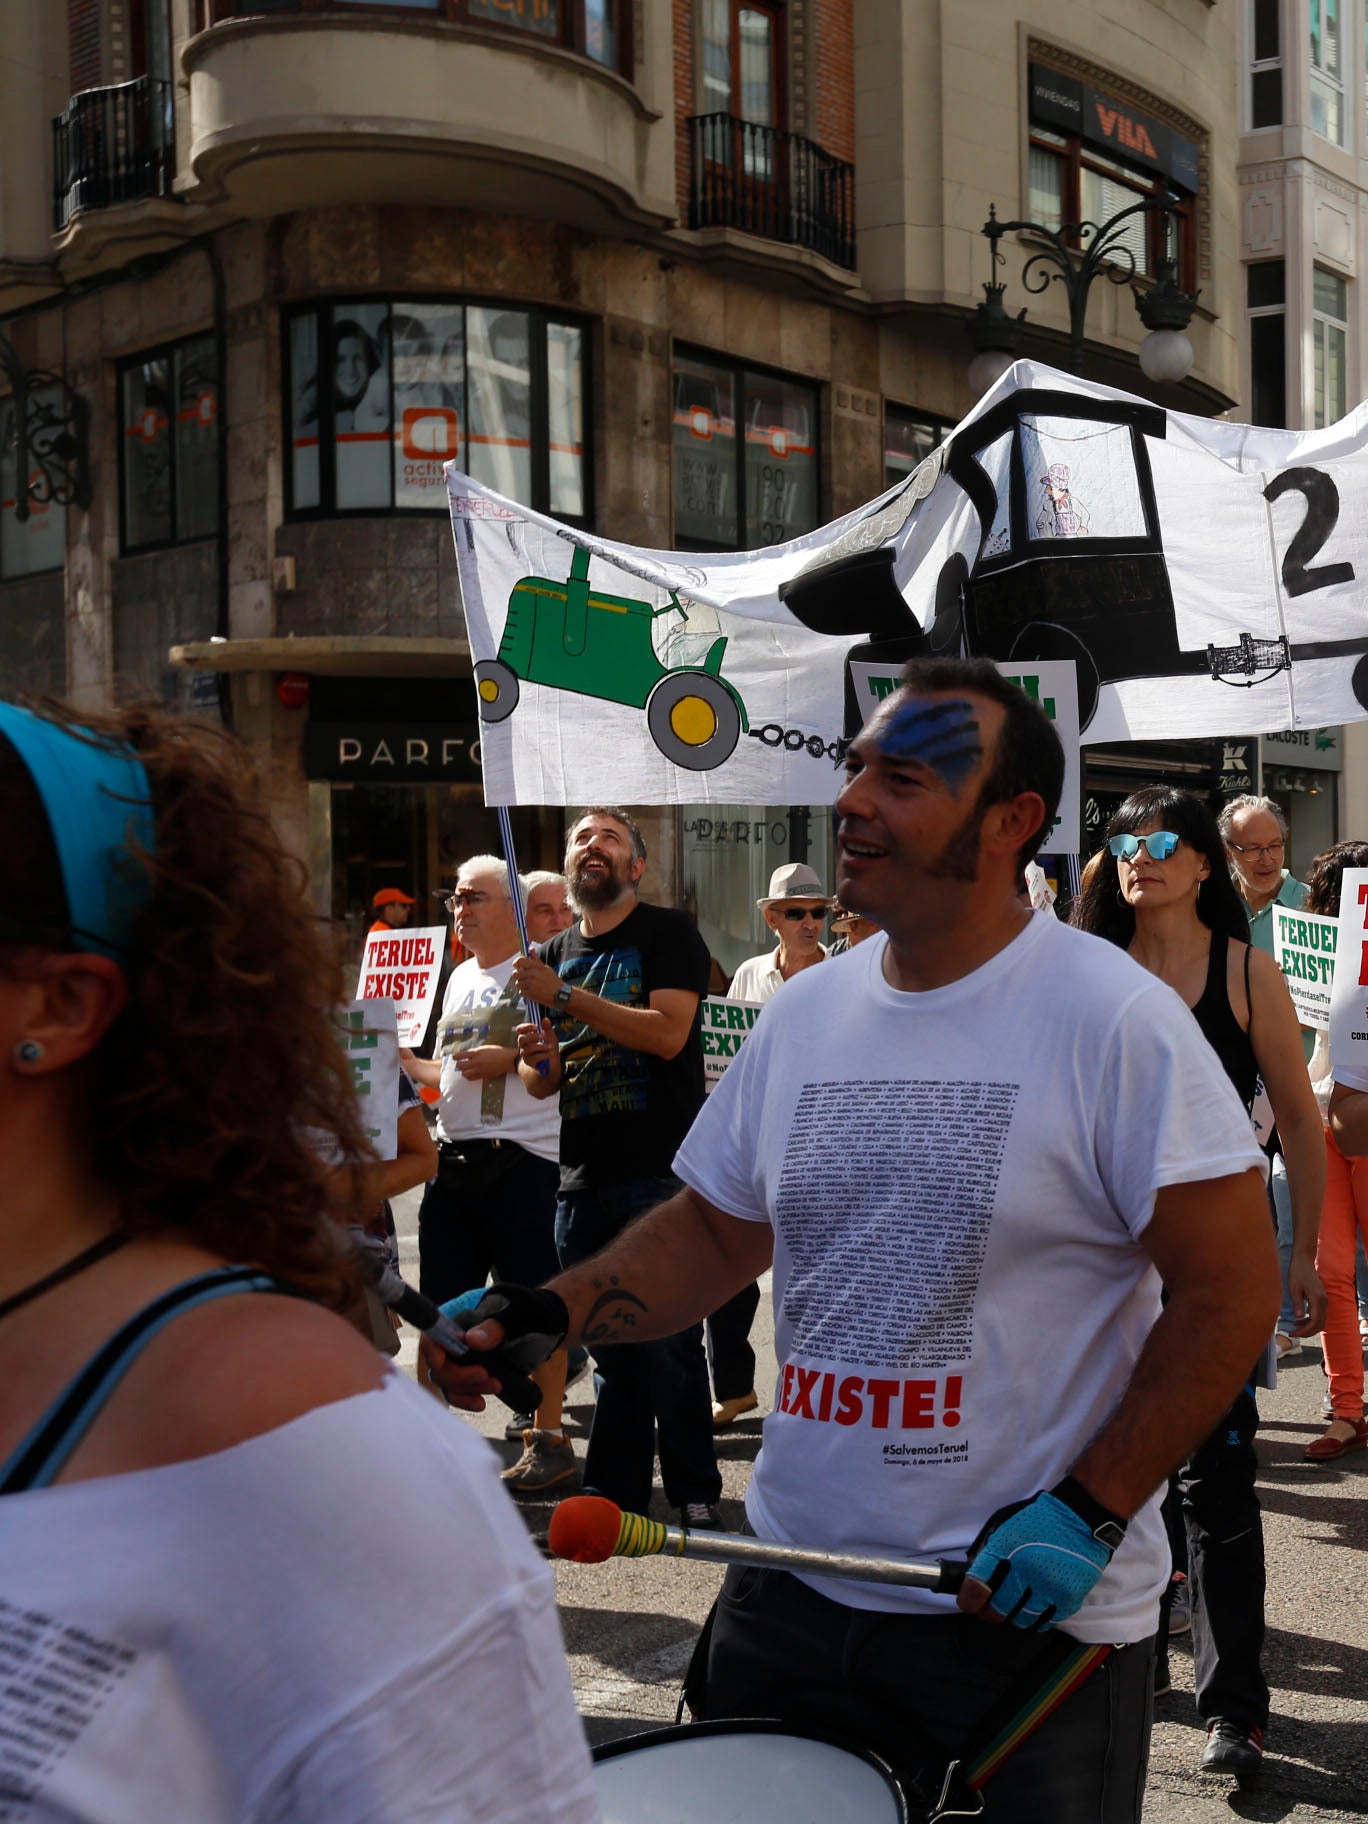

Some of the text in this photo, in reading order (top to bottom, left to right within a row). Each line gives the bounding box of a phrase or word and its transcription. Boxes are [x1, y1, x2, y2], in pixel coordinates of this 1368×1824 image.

[367, 937, 435, 968] TERUEL
[363, 971, 430, 1000] EXISTE
[777, 1363, 963, 1429] EXISTE!
[883, 1440, 968, 1456] #SalvemosTeruel
[884, 1458, 911, 1467] Domingo,
[927, 1458, 942, 1467] mayo
